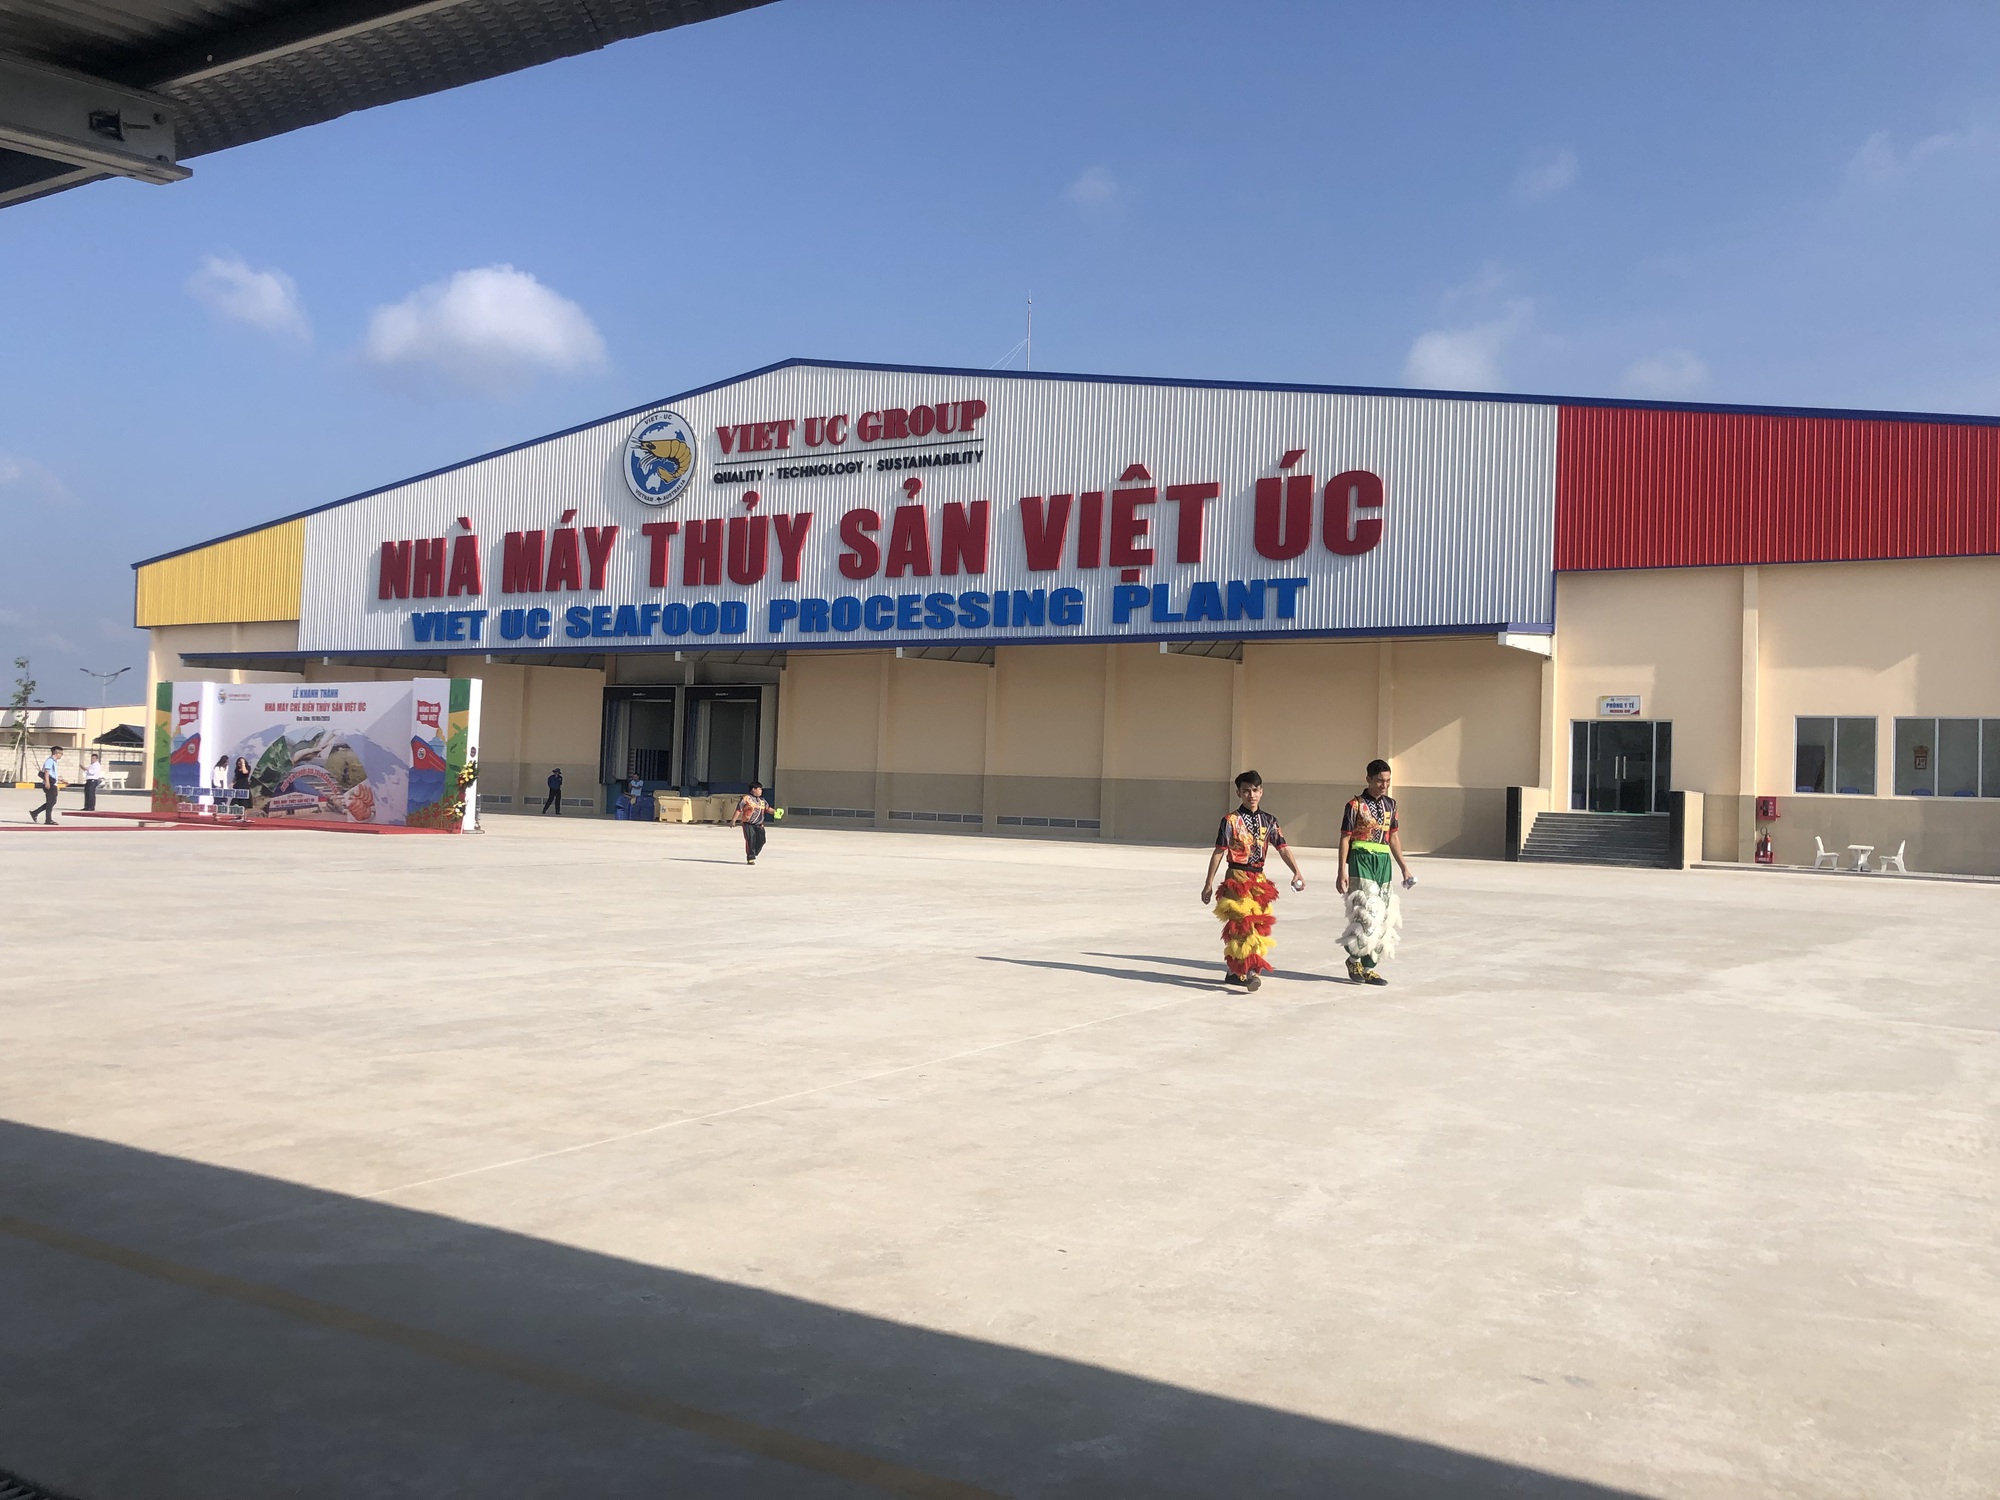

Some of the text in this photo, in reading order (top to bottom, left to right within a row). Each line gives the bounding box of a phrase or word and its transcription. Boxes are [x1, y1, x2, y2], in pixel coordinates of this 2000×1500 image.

[644, 414, 659, 426] VIET
[716, 400, 987, 454] VIET UC GROUP
[713, 450, 984, 484] QUALITY TECHNOLOGY SUSTAINABILITY
[663, 479, 686, 500] AUSTRALIA
[379, 449, 1384, 599] NHÀ MÁY THỦY SẢN VIỆT ÚC
[411, 577, 1310, 642] VIET UC SEAFOOD PROCESSING PLANT
